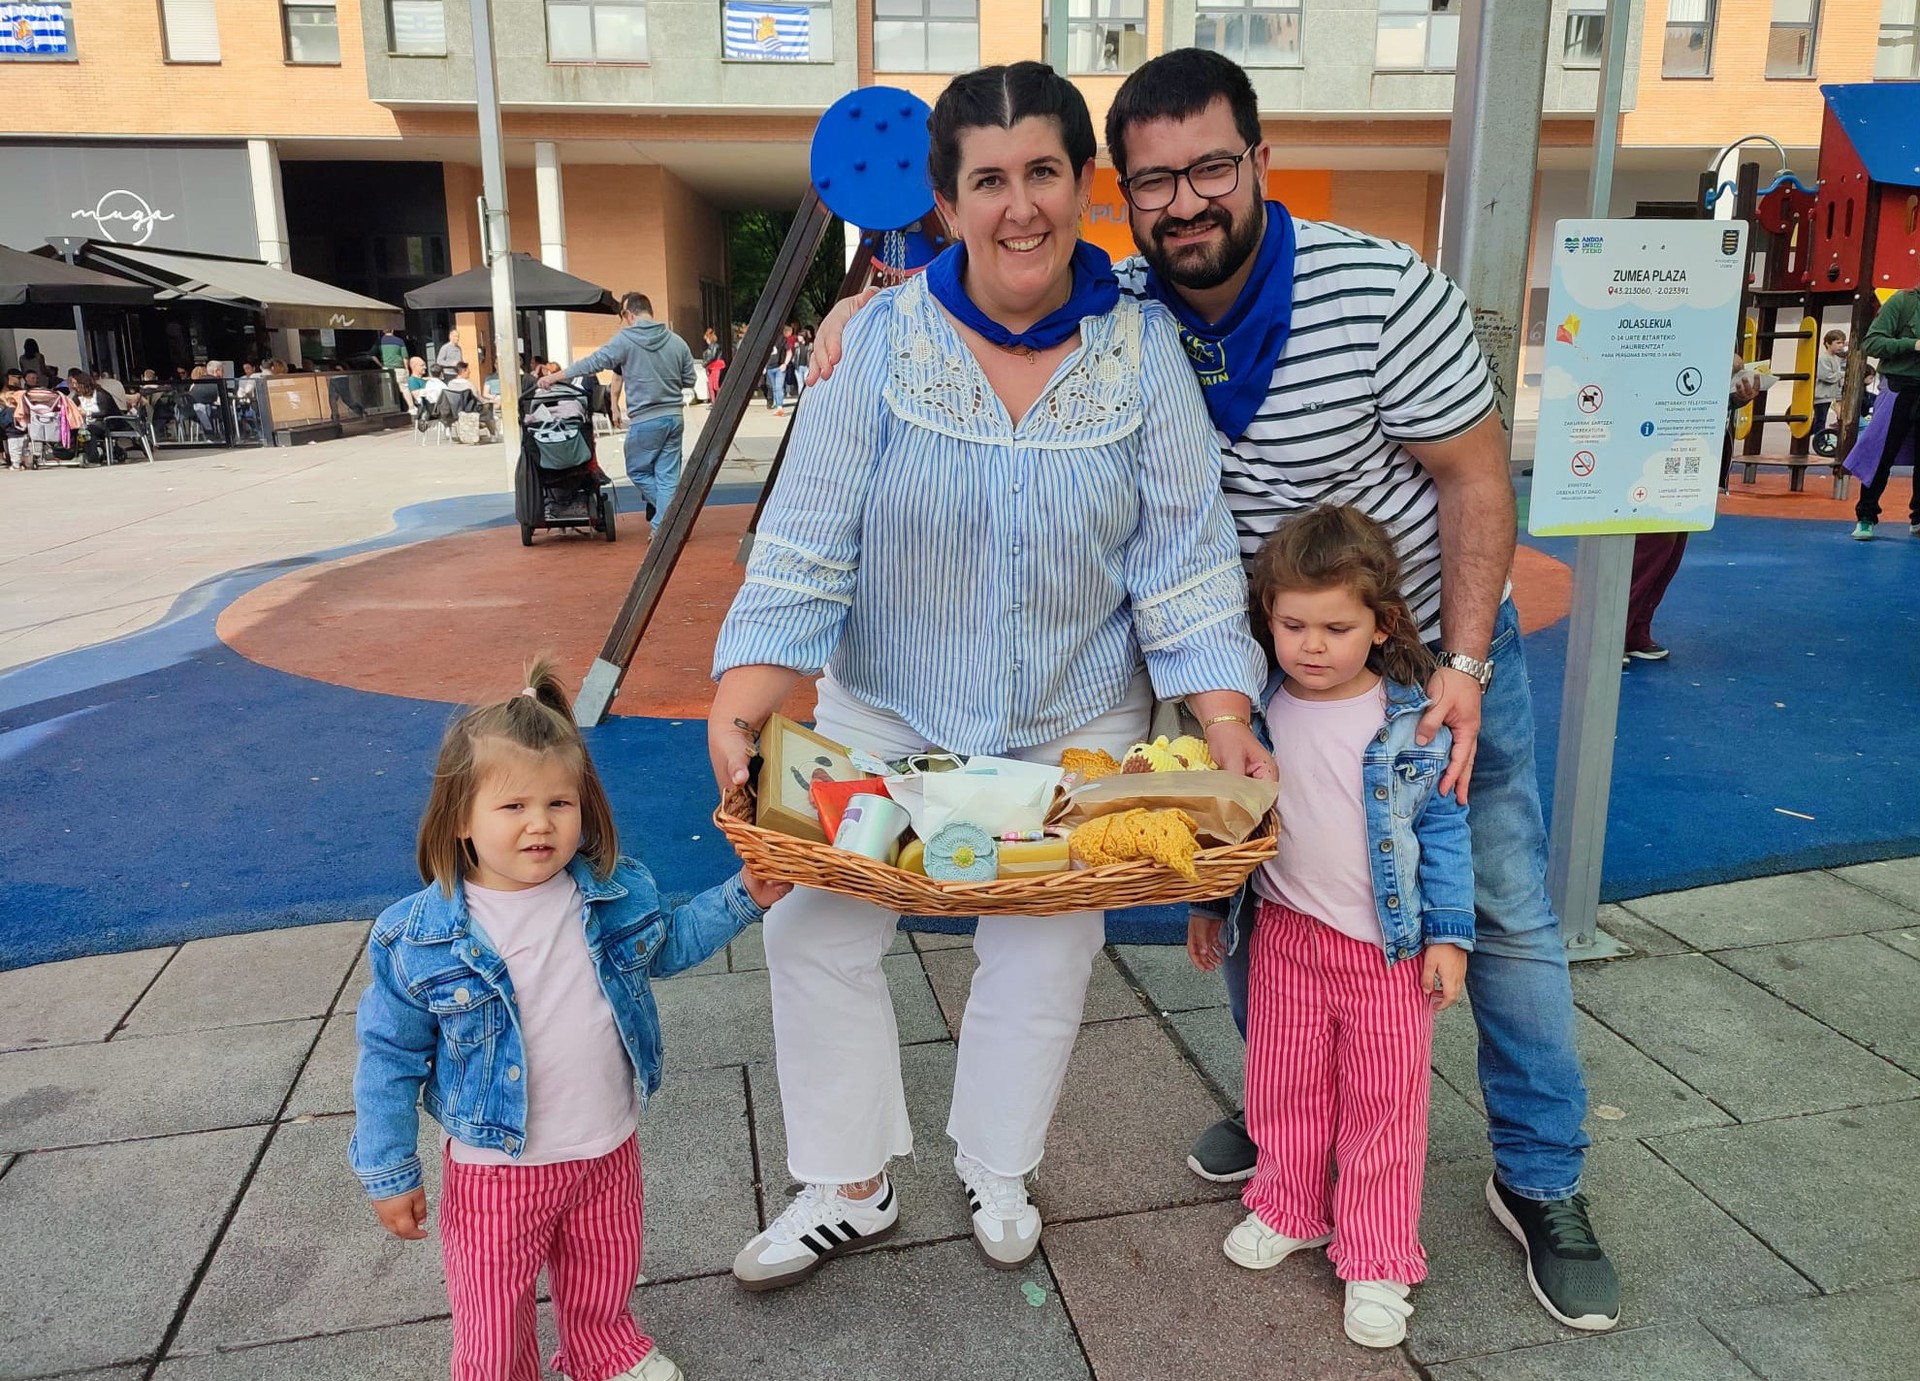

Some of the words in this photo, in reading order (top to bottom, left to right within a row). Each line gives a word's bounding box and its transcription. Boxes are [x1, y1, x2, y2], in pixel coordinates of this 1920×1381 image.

[1613, 270, 1650, 281] ZUMEA
[1652, 270, 1687, 281] PLAZA
[1613, 287, 1653, 295] 43.213060,
[1655, 287, 1689, 295] -2.023391
[1618, 319, 1672, 329] JOLASLEKUA
